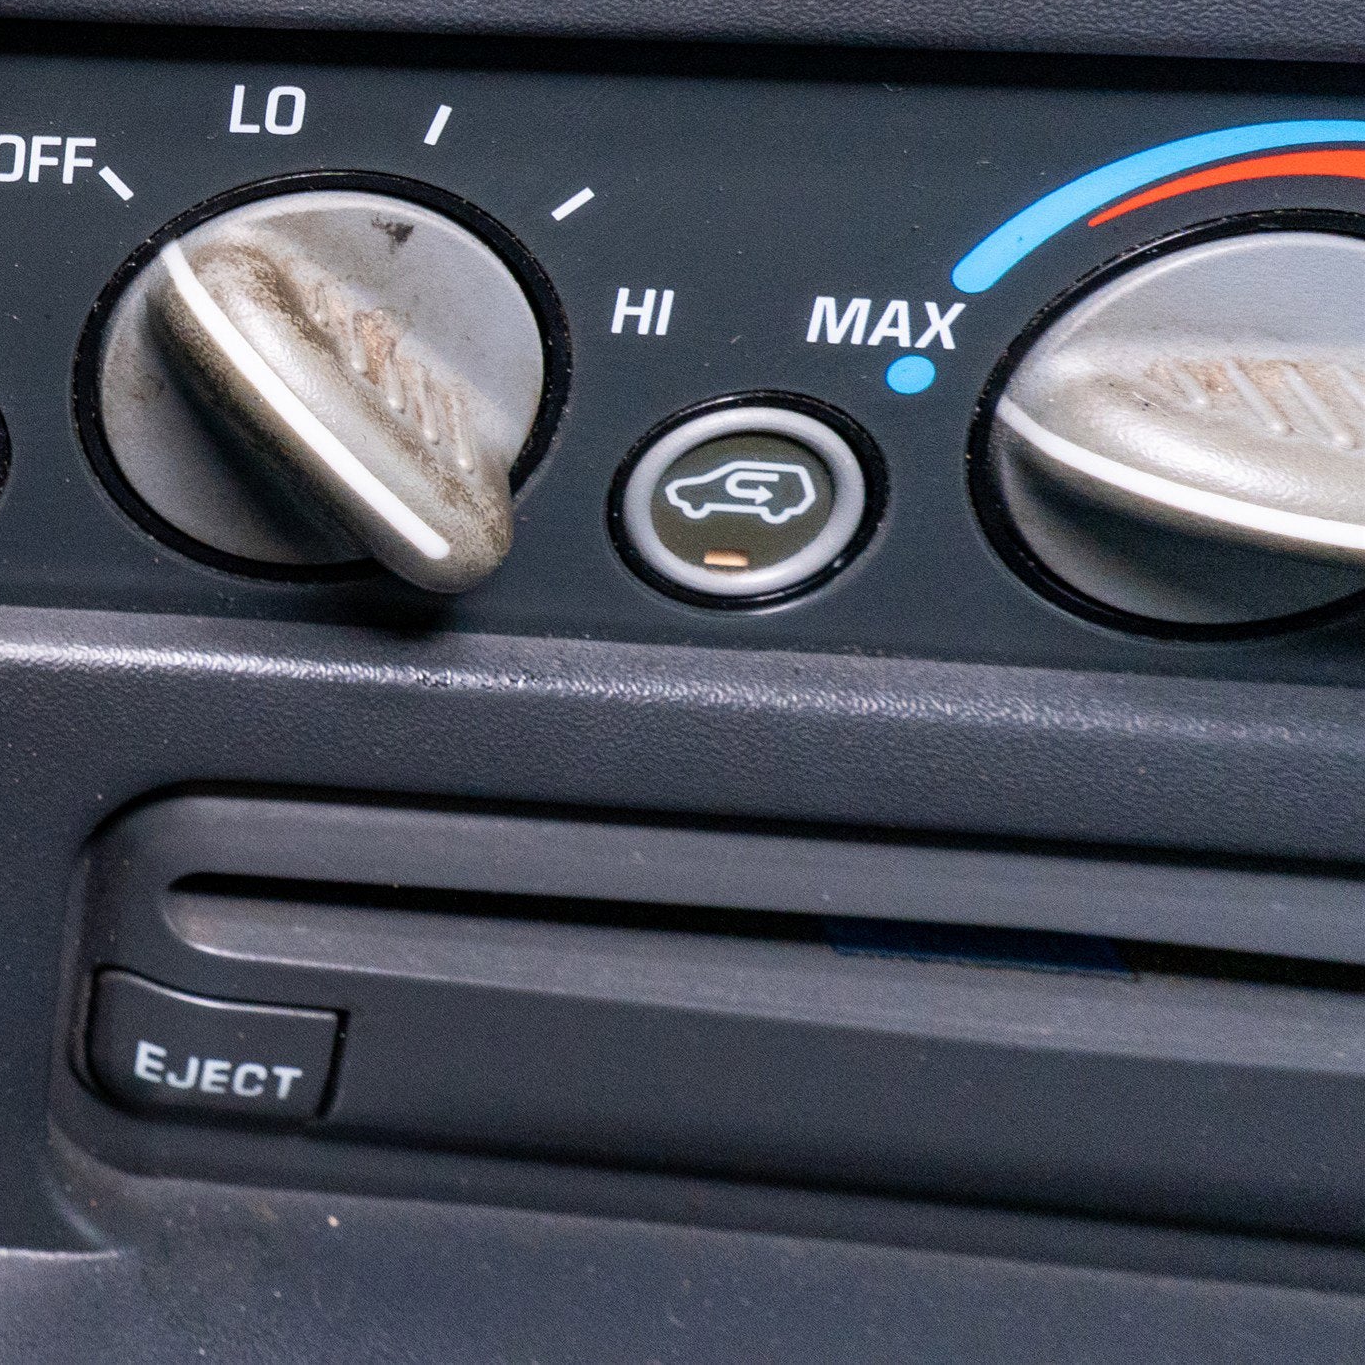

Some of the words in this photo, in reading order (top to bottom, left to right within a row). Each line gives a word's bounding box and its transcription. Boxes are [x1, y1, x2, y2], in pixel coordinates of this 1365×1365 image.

[229, 84, 307, 137] LO
[610, 287, 676, 337] HI
[806, 295, 967, 351] MAX
[132, 1039, 305, 1104] EJECT
